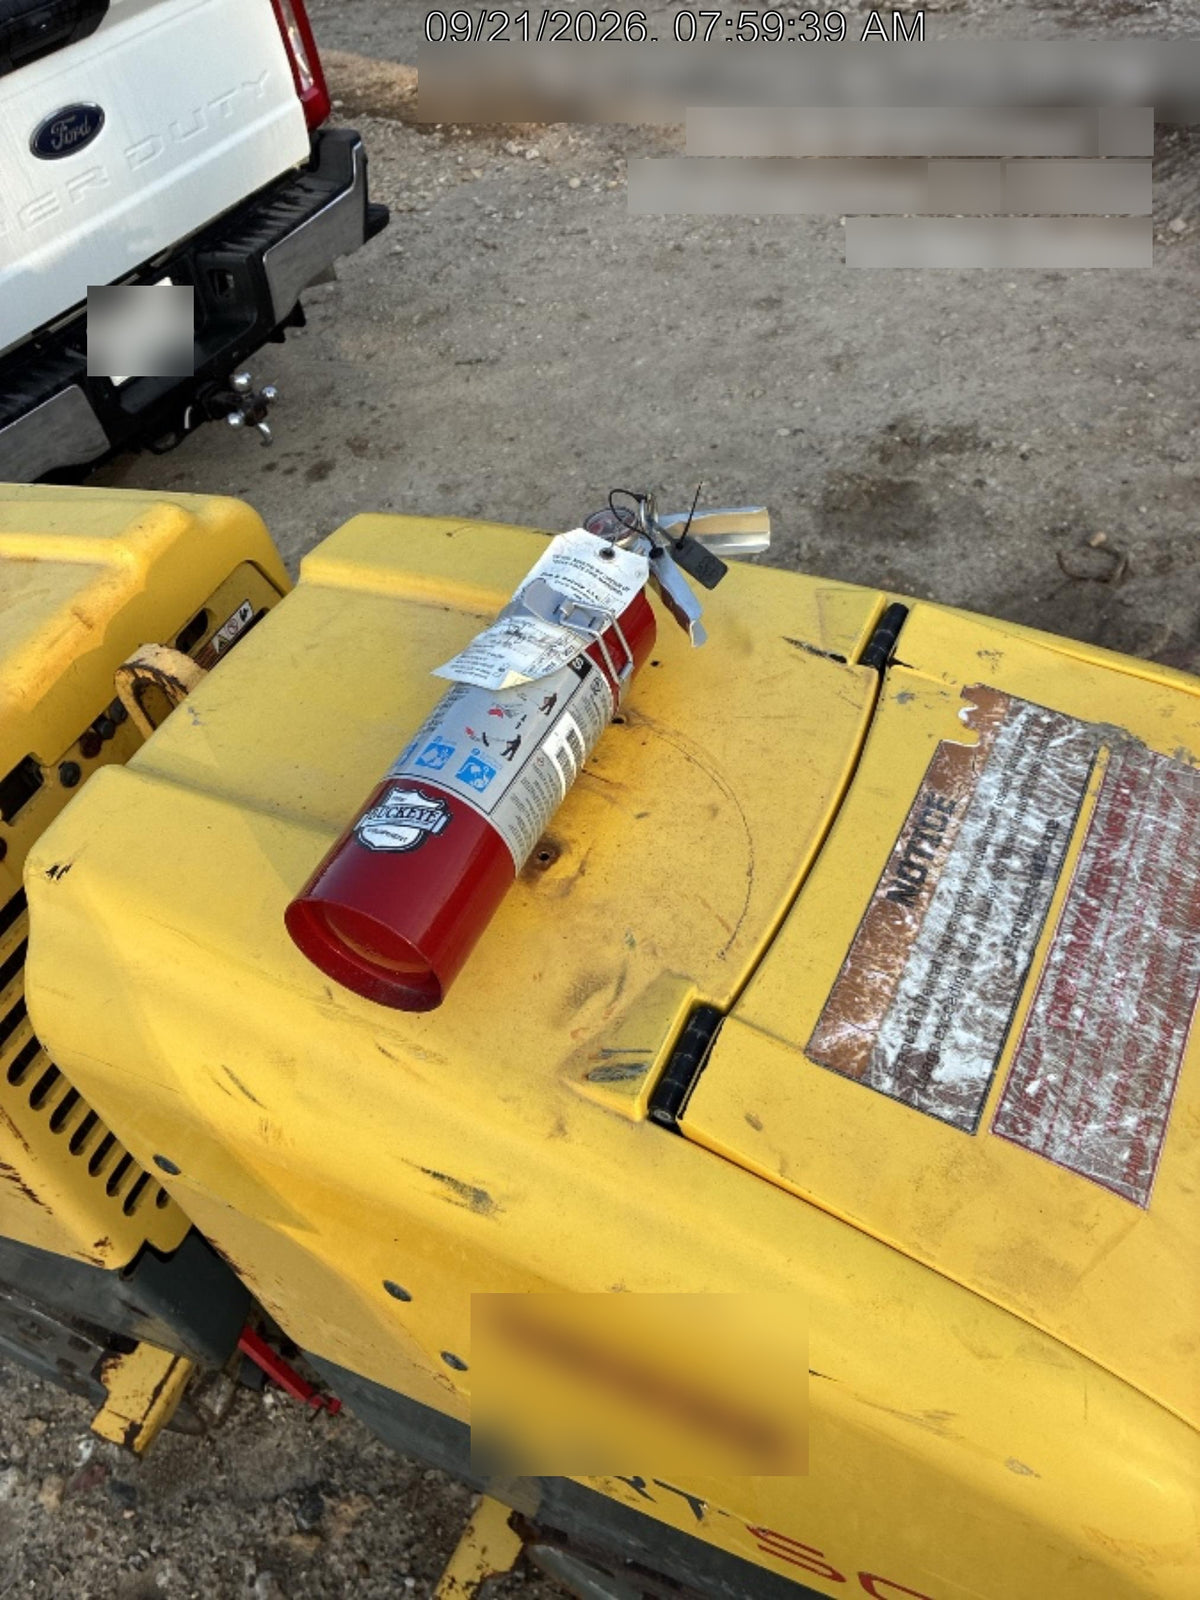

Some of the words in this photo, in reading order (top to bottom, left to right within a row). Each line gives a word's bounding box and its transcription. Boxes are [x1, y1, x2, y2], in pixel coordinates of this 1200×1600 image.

[0, 164, 111, 235] ER
[124, 70, 271, 171] DUTY
[50, 115, 91, 150] Ford
[367, 805, 439, 823] BUCKEYE
[885, 790, 956, 907] NOTICE
